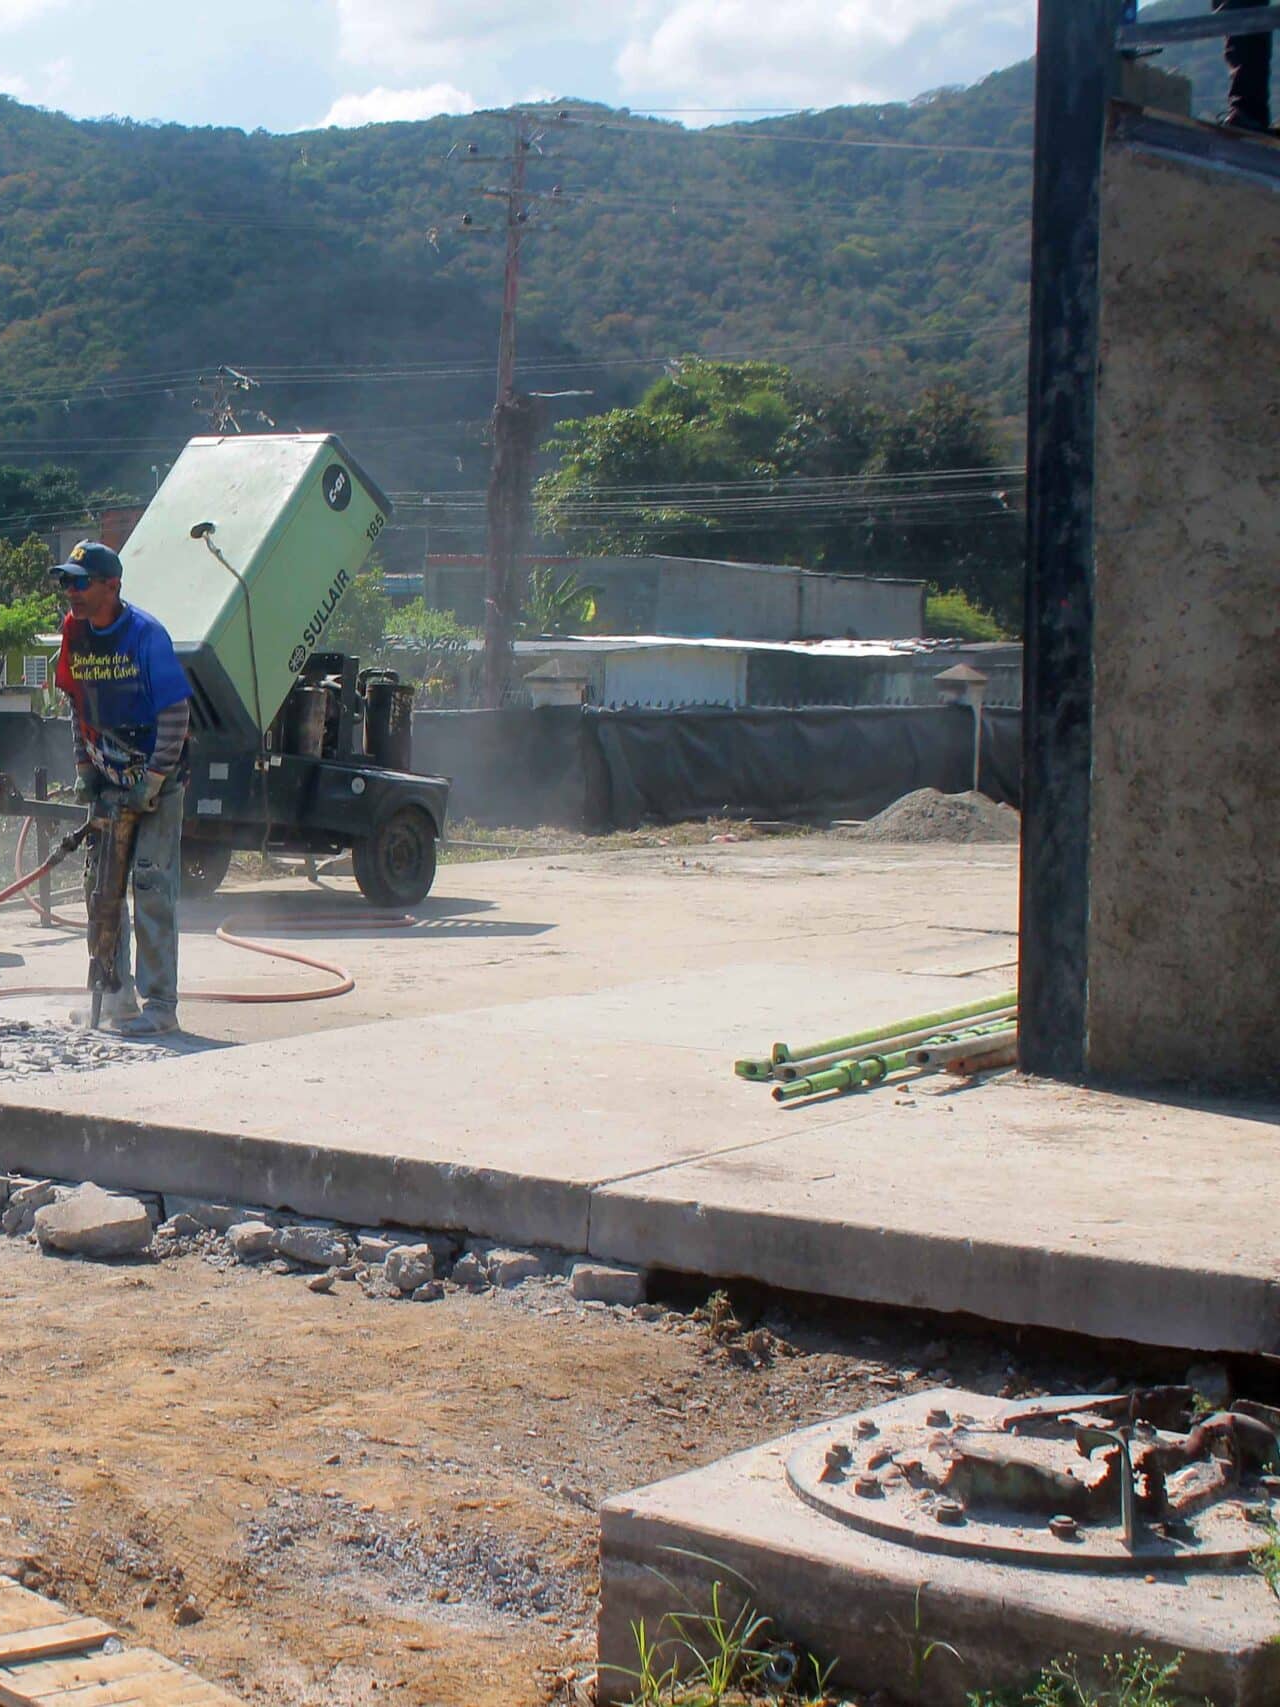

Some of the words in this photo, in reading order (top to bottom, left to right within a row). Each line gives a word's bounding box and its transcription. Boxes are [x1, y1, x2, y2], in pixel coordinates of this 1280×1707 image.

[329, 472, 345, 503] C-01
[366, 513, 384, 542] 185
[303, 568, 350, 648] SULLAIR
